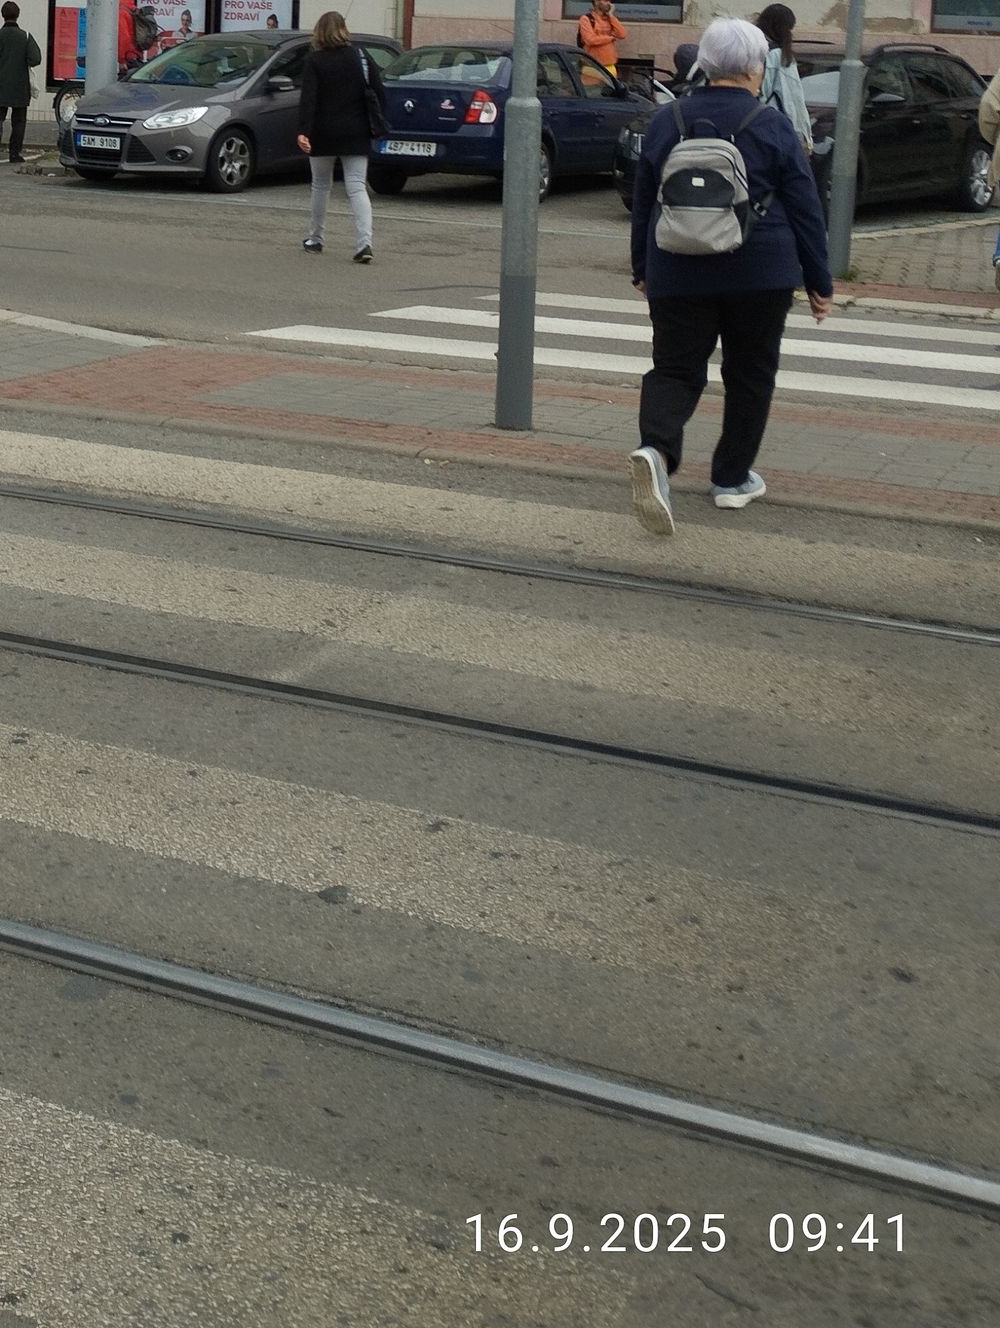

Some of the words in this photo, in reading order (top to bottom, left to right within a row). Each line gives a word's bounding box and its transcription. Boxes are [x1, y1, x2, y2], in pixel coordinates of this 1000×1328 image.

[224, 0, 245, 9] PRO
[246, 0, 273, 10] VAŠE
[224, 11, 260, 21] ZDRAVÍ
